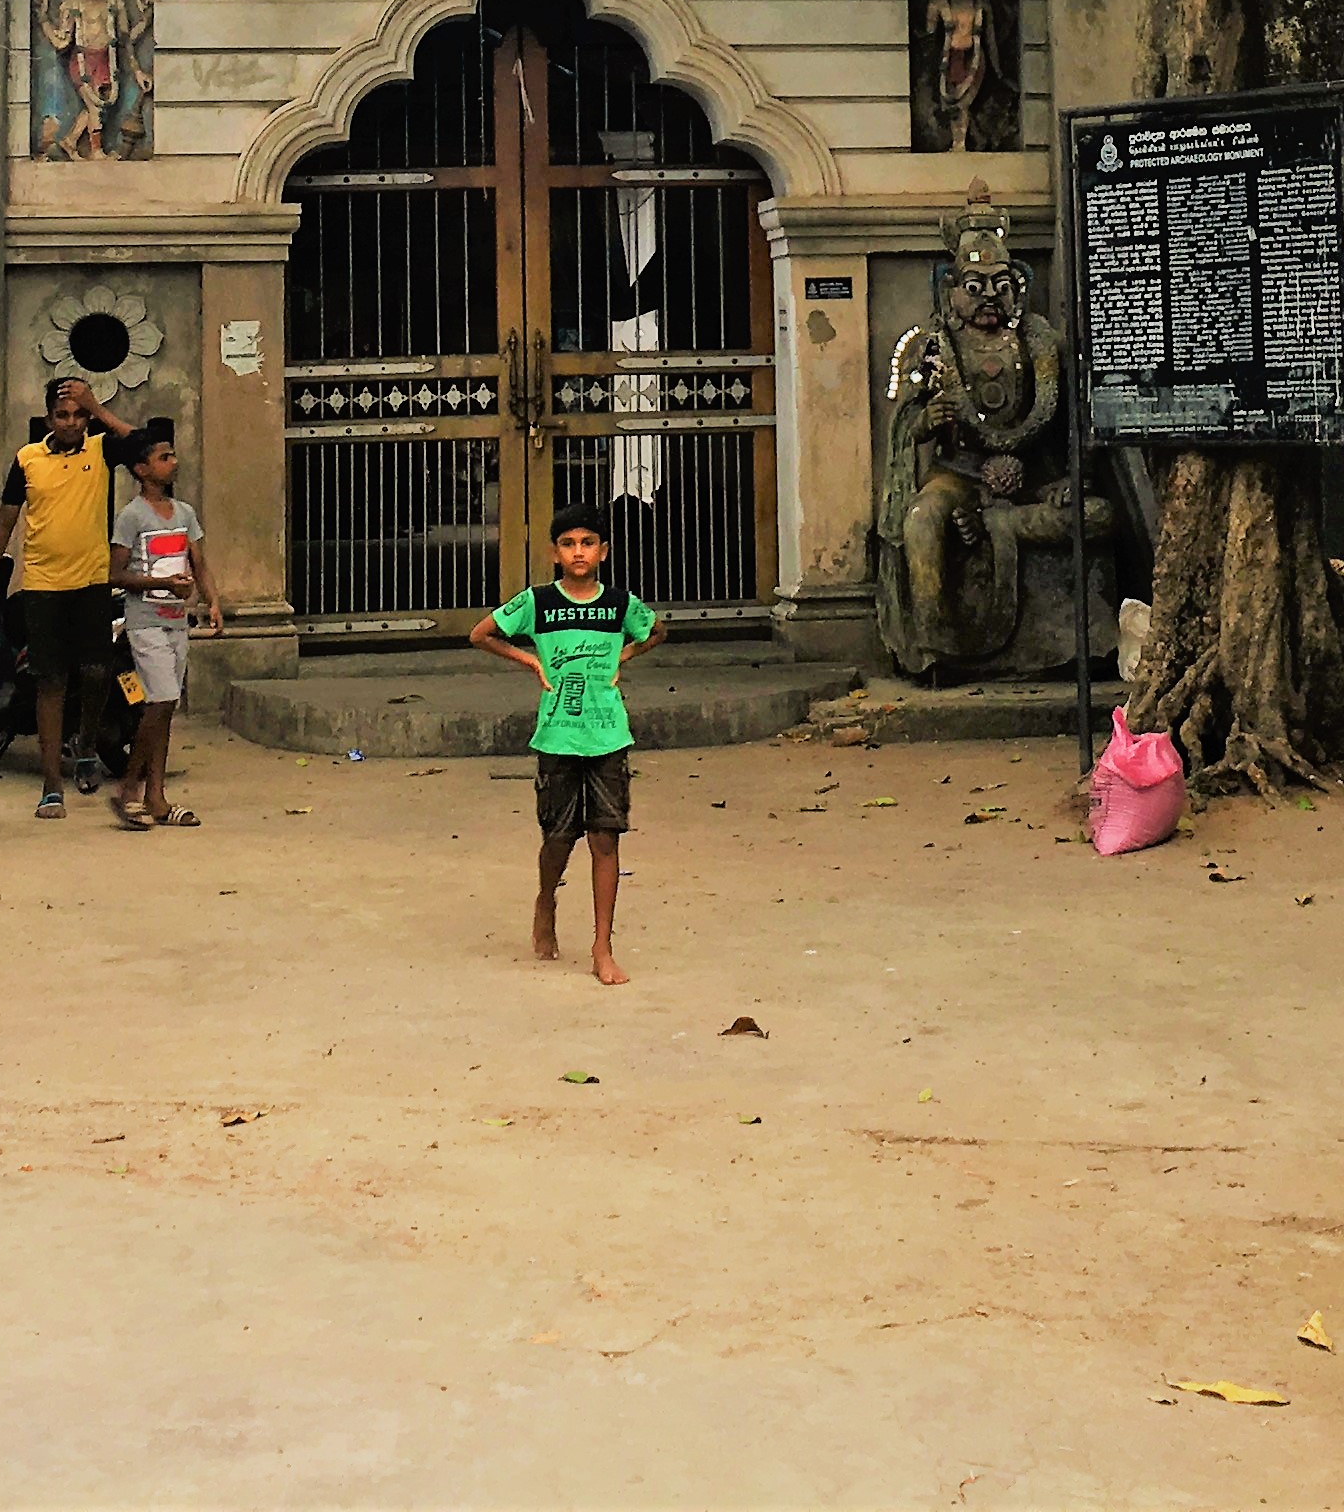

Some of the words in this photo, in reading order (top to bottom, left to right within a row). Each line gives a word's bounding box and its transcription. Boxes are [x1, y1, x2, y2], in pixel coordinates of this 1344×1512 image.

[1130, 156, 1170, 168] PROTECTED
[1171, 152, 1223, 165] ARCHAEOLOGY
[1224, 148, 1264, 160] MONUMENT
[544, 607, 617, 623] WESTERN
